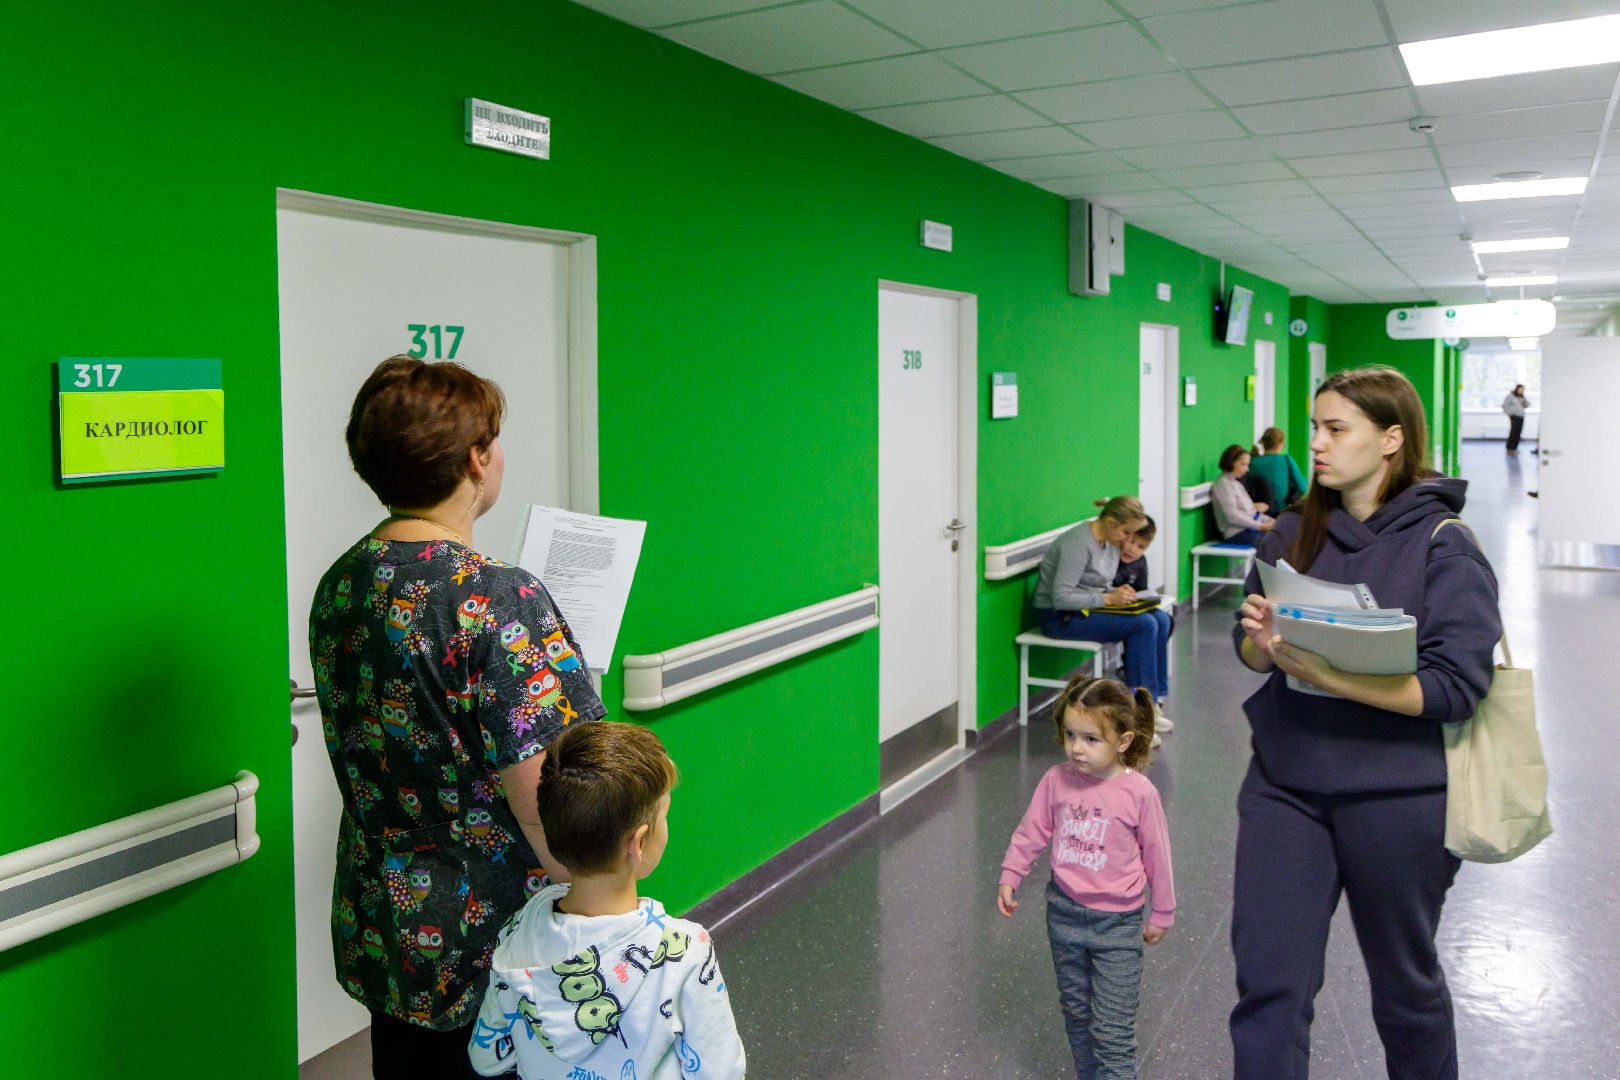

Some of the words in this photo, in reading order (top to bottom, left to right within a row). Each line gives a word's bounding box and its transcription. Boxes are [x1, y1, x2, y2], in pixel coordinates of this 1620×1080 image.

[497, 111, 549, 134] ВХОДИТЬ
[486, 127, 538, 150] ВХОДИТЕ
[408, 324, 465, 359] 317
[902, 350, 922, 369] 318
[74, 364, 122, 387] 317
[85, 420, 208, 439] КАРДИОЛОГ
